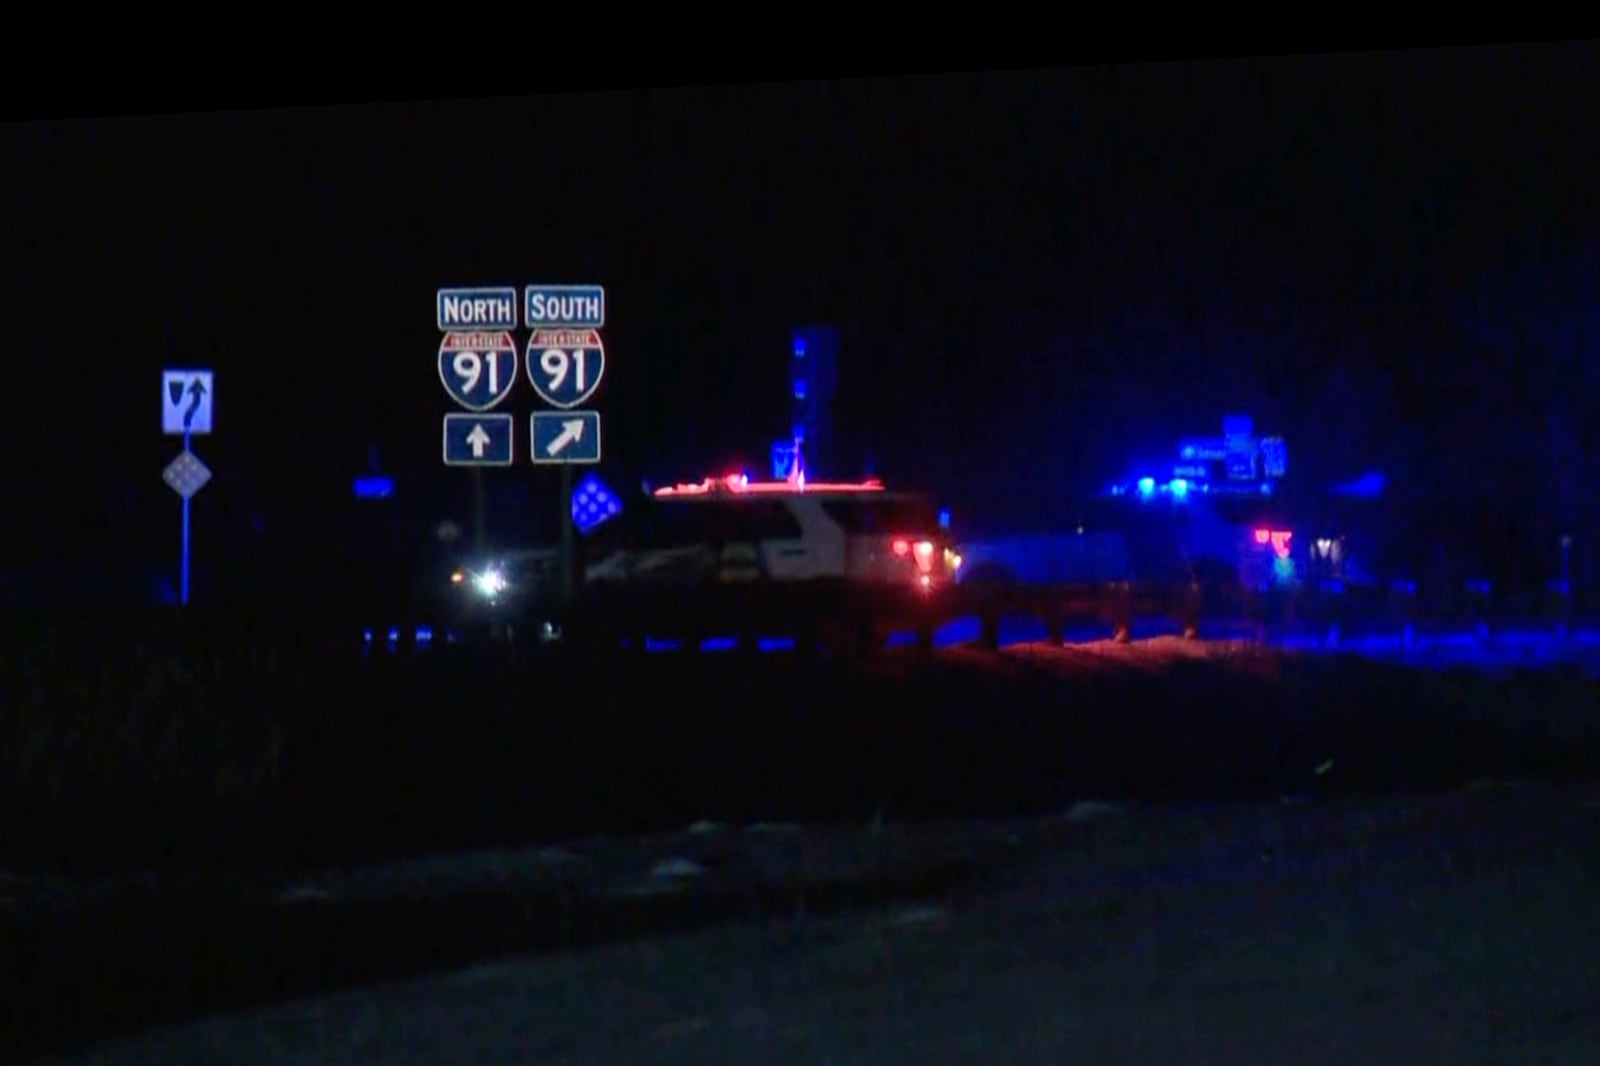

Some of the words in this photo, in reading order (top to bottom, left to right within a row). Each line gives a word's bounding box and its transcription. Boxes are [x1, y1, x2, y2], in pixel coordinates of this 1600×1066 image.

[445, 297, 510, 322] NORTH
[532, 293, 598, 319] SOUTH
[453, 352, 497, 394] 91
[541, 349, 584, 392] 91
